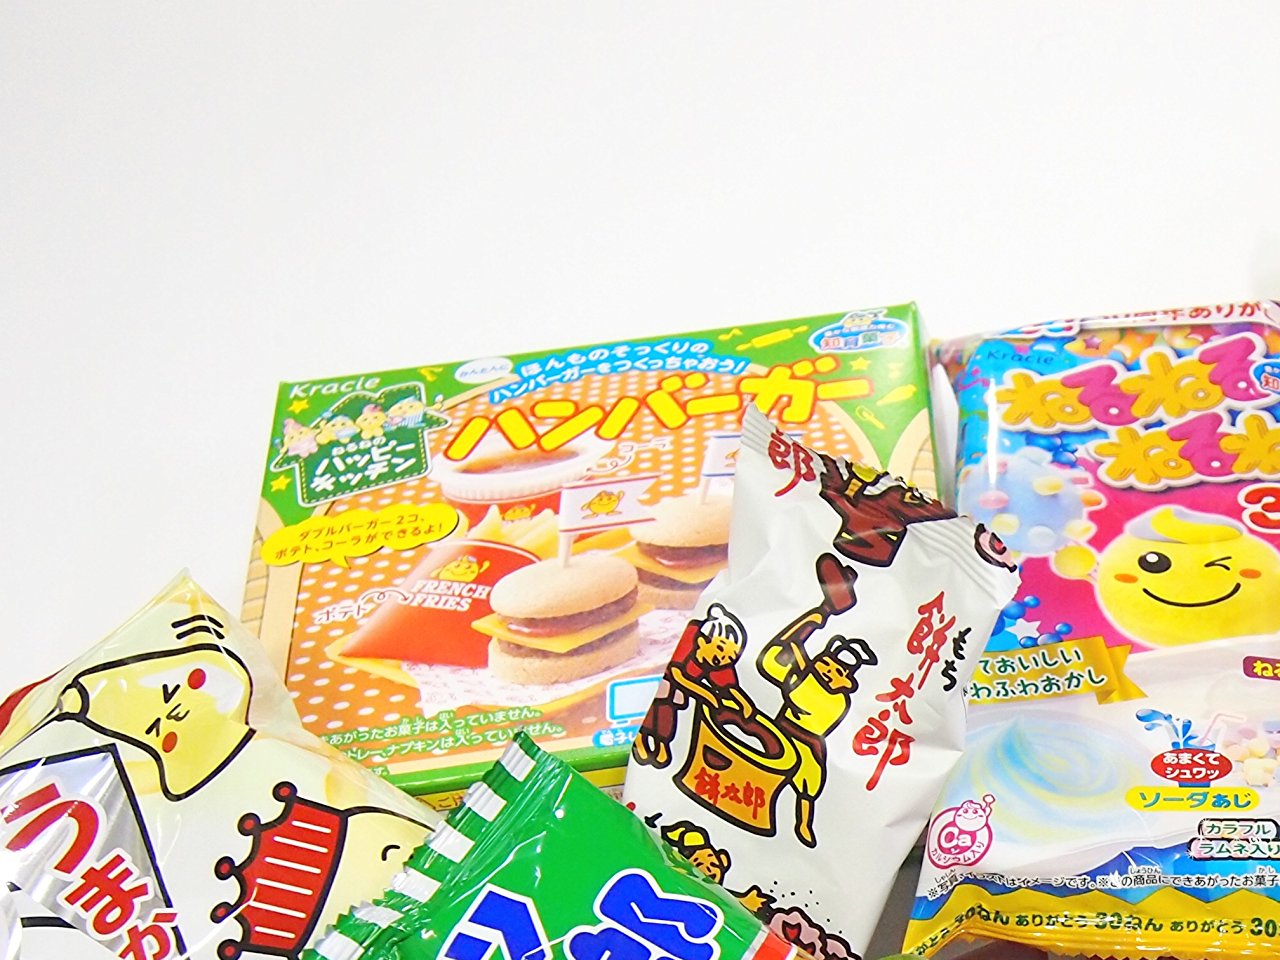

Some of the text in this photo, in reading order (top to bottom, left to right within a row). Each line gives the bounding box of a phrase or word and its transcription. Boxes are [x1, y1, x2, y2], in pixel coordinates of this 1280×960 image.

[521, 342, 710, 378] ほんものそっくりの
[289, 376, 381, 399] Kracie
[997, 334, 1263, 428] ねるねる
[443, 355, 876, 461] ハンバーガー
[314, 441, 416, 476] ハッピー
[309, 457, 417, 491] キッチン
[412, 580, 492, 601] FRENCH
[411, 596, 473, 613] FRIES
[940, 626, 972, 694] もち
[962, 669, 1107, 701] わふわおかし
[1162, 750, 1220, 767] あまくて
[1137, 791, 1252, 810] ソーダあじ
[1205, 821, 1272, 837] カラフル
[1168, 916, 1245, 937] ありがとう
